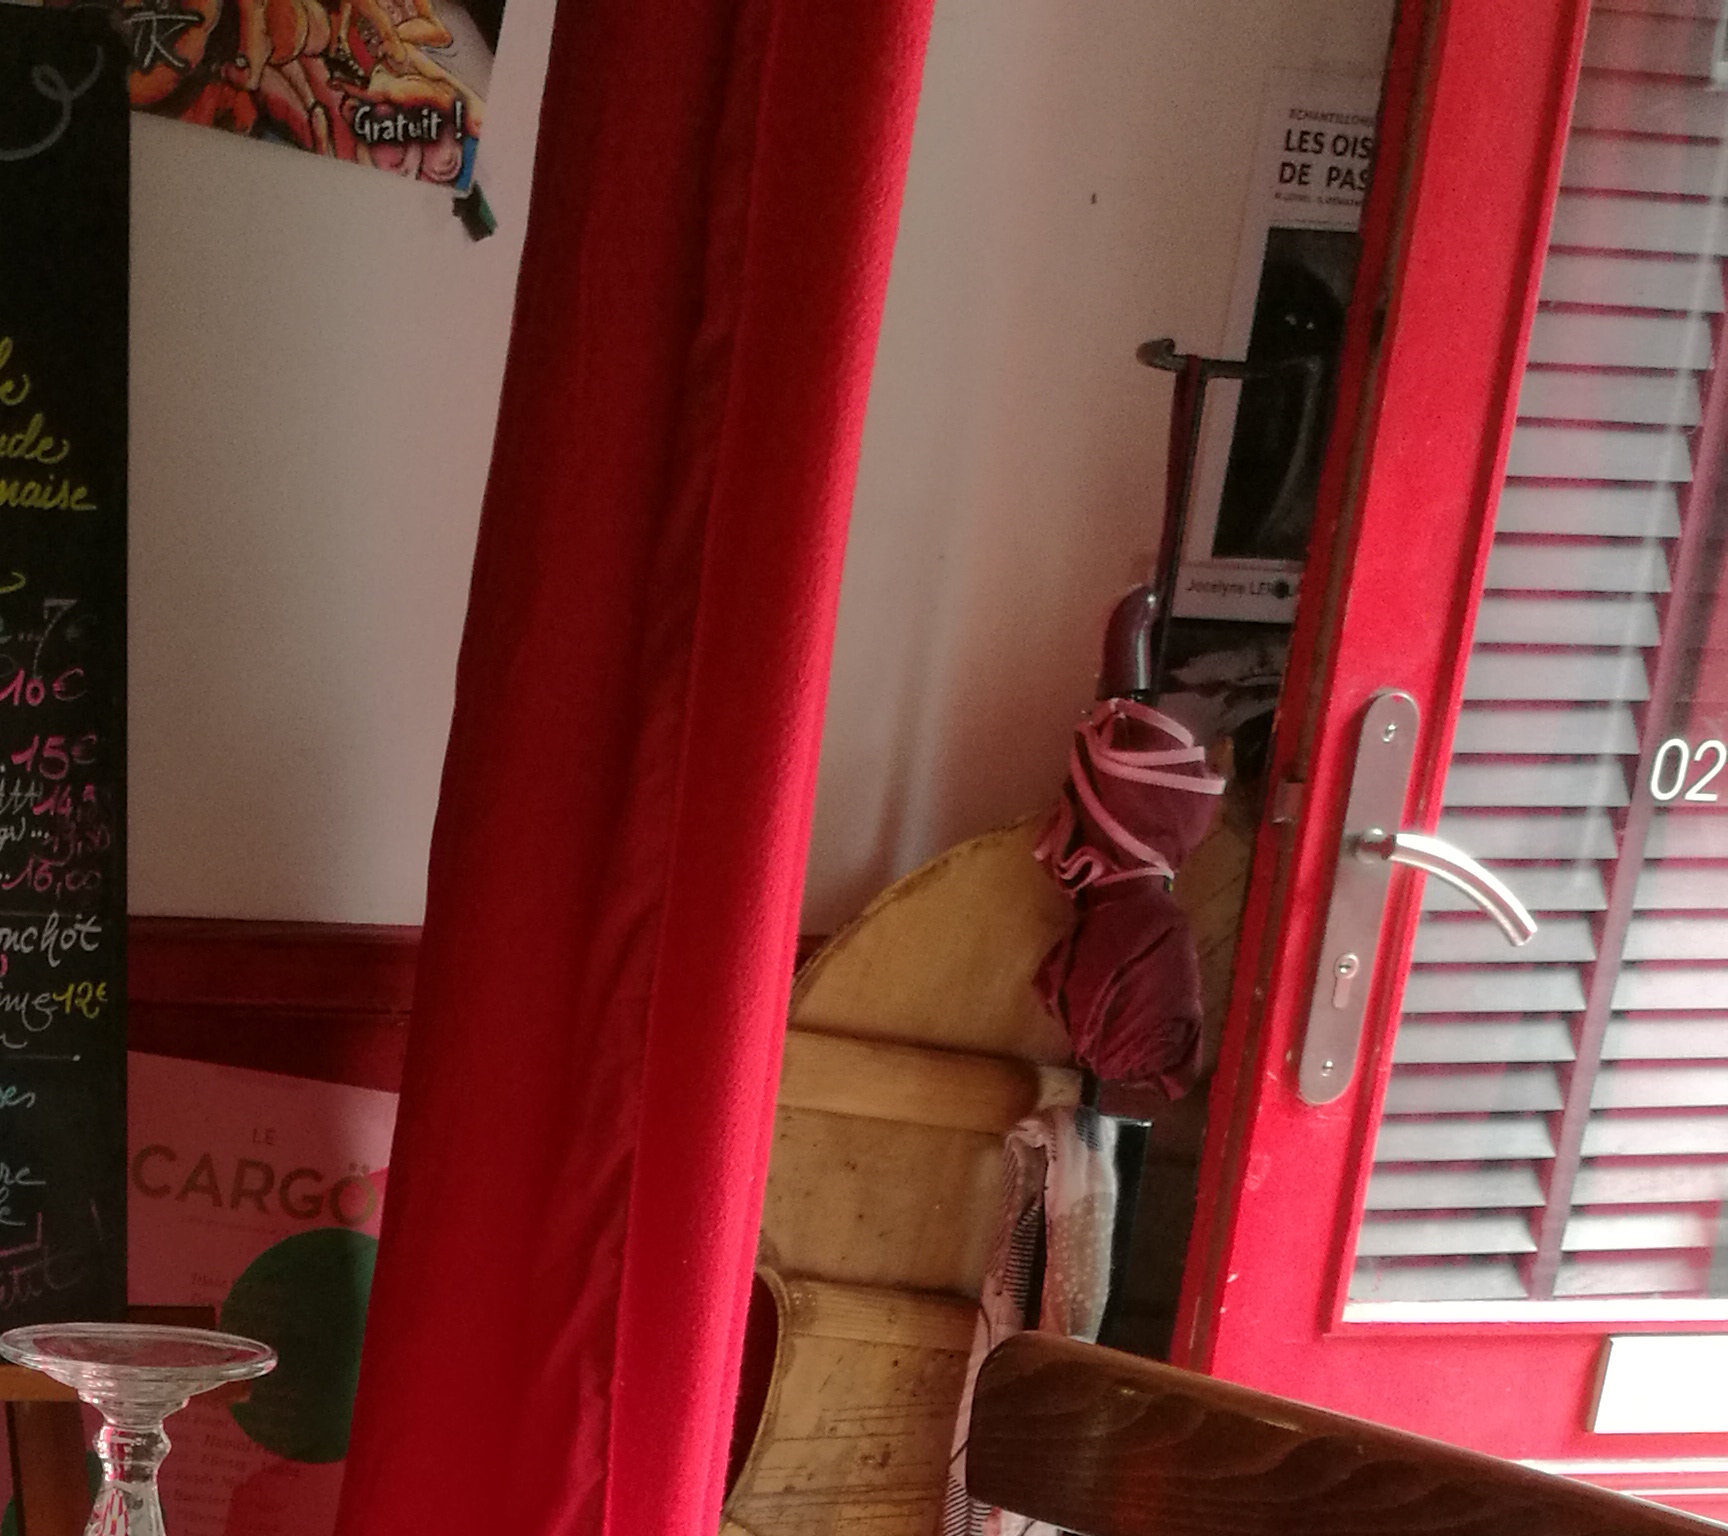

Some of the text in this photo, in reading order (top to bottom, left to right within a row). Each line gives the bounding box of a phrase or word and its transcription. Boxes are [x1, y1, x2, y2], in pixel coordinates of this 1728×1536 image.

[354, 105, 443, 144] Gratuit
[1283, 128, 1325, 155] LES
[1279, 161, 1312, 186] DE
[1650, 737, 1728, 802] 02
